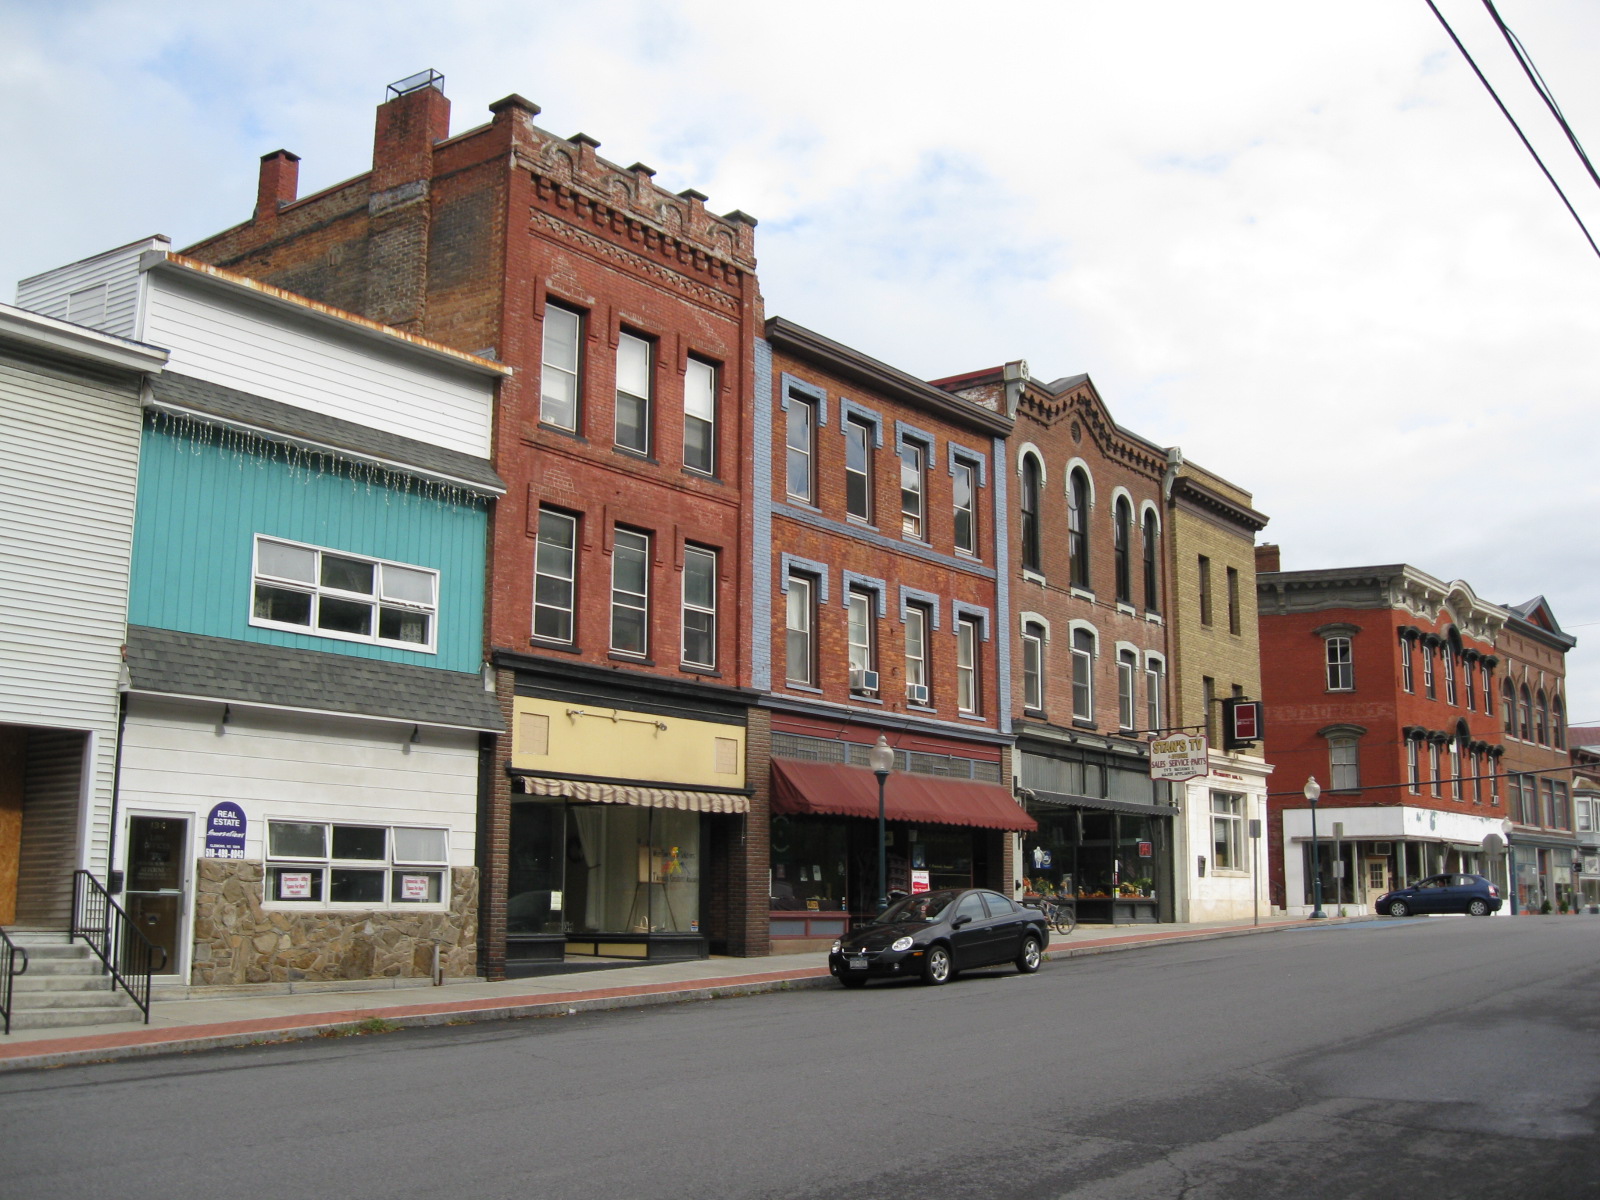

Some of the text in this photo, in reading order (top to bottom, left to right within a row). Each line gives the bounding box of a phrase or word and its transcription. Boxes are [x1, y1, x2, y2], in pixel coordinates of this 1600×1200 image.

[1152, 738, 1203, 754] STAN'S TV
[1151, 757, 1207, 768] SALES SERVICE PARTS
[217, 810, 238, 819] REAL
[213, 818, 240, 827] ESTATE
